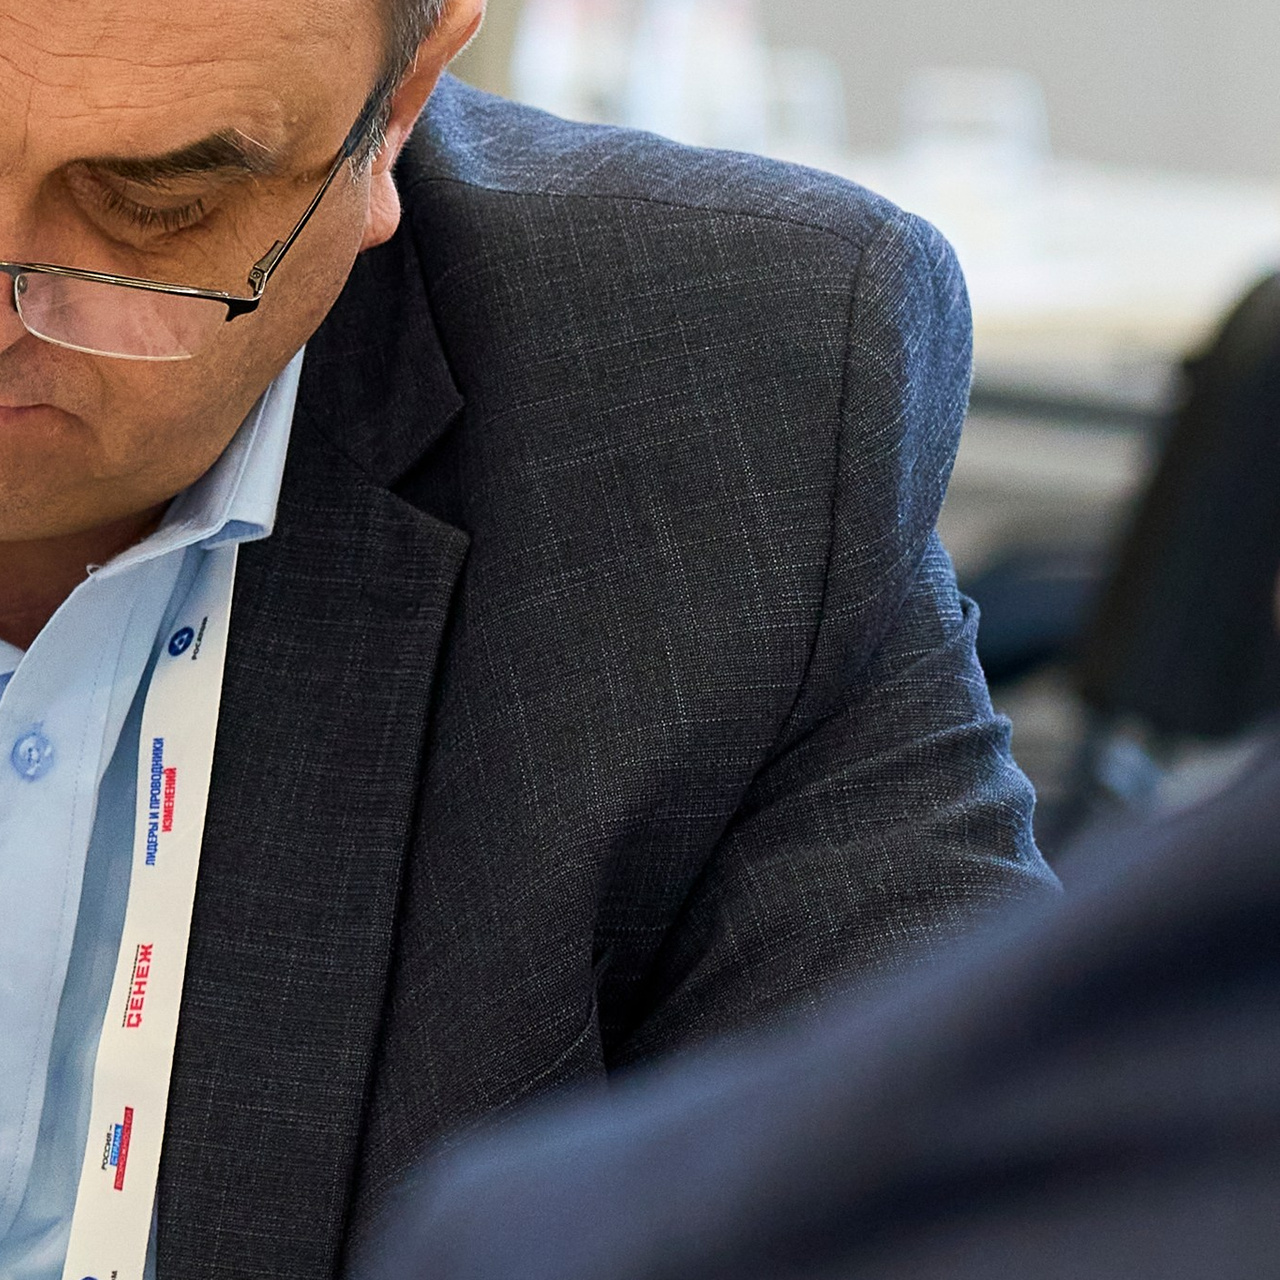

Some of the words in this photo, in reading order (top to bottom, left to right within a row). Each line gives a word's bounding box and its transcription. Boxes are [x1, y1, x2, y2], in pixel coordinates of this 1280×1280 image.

[191, 616, 208, 660] РОСА
[149, 737, 164, 809] ПРОВОДНИКИ
[162, 768, 176, 832] ИЗМЕНЕНИЙ
[145, 822, 158, 865] ЛИДЕРЫ
[126, 944, 153, 1027] СЕНЕЖ
[101, 1132, 111, 1170] РОССИЯ
